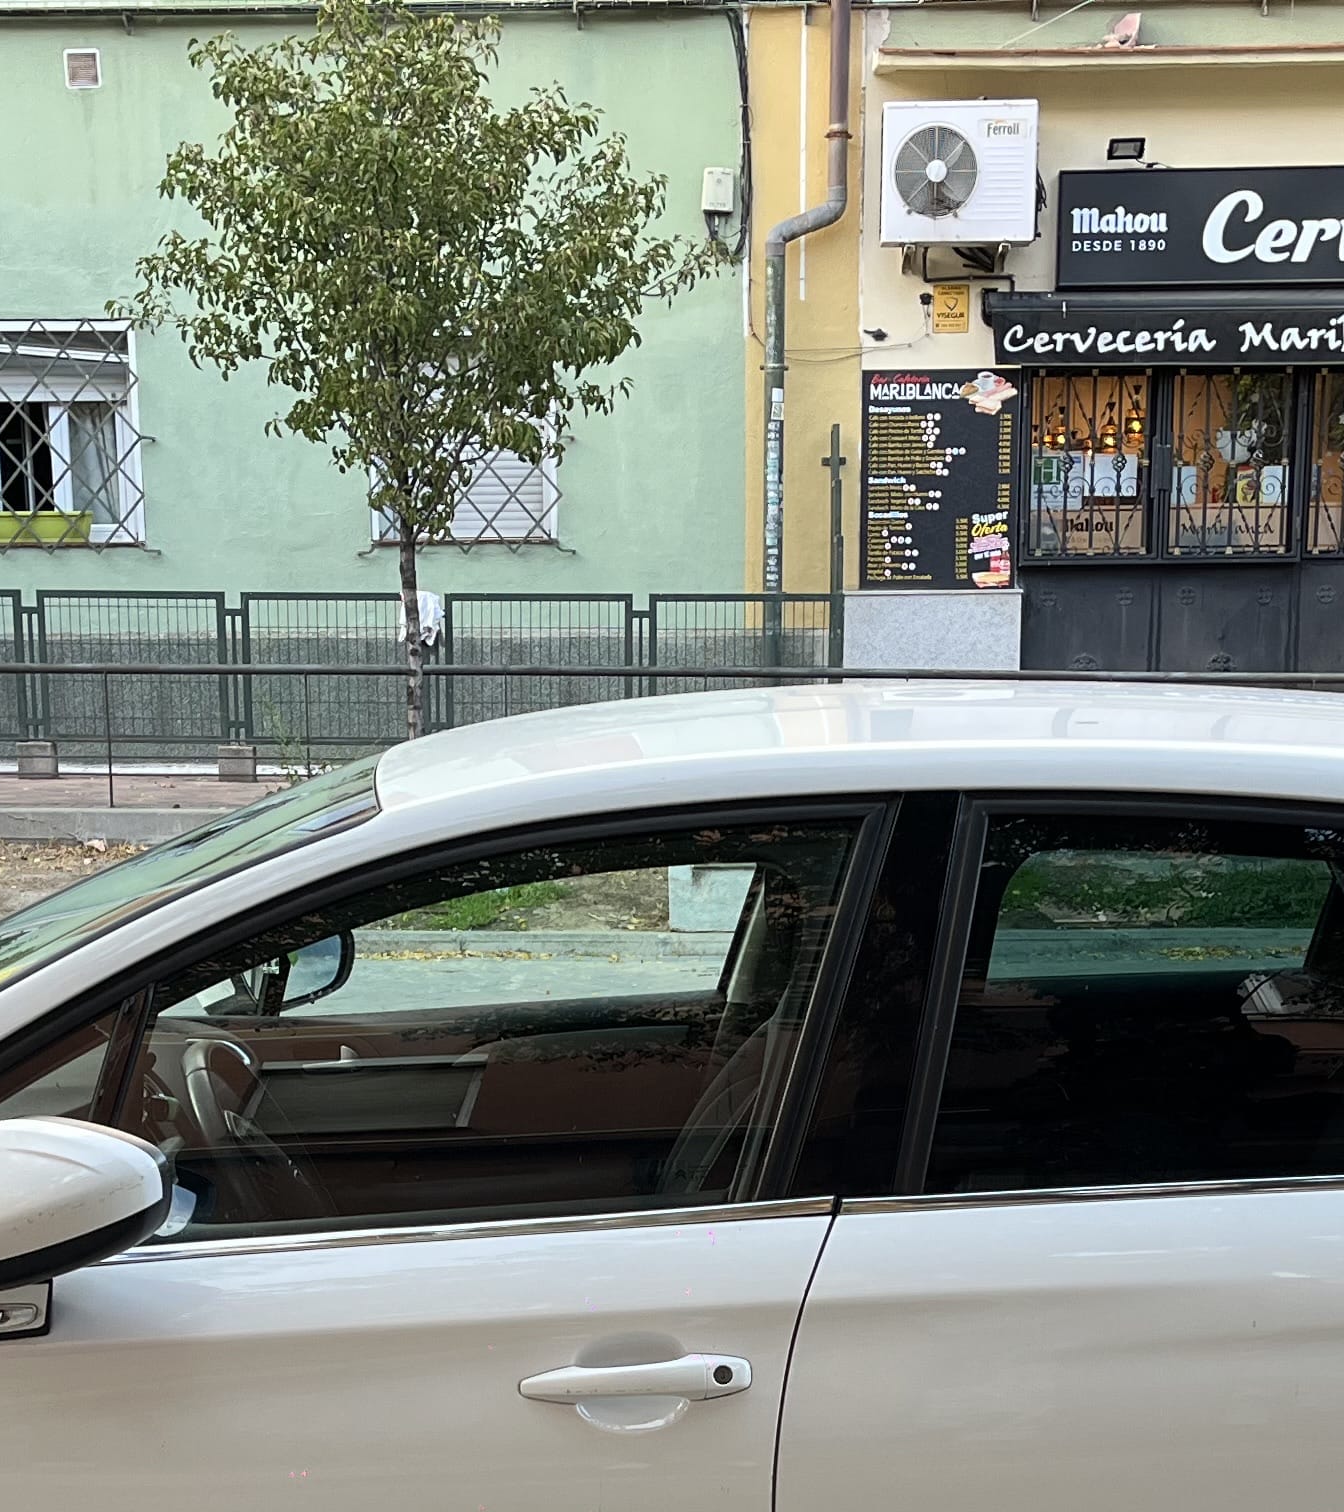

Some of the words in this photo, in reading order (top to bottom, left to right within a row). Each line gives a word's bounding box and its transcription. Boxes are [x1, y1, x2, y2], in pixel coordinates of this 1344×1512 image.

[1070, 206, 1168, 234] Mahou
[1072, 240, 1122, 252] DESDE
[1129, 239, 1166, 251] 1890
[1002, 319, 1217, 354] Cervecería
[869, 382, 961, 400] MARIBLANCA
[972, 511, 1008, 524] Super
[971, 522, 1008, 537] Oferta
